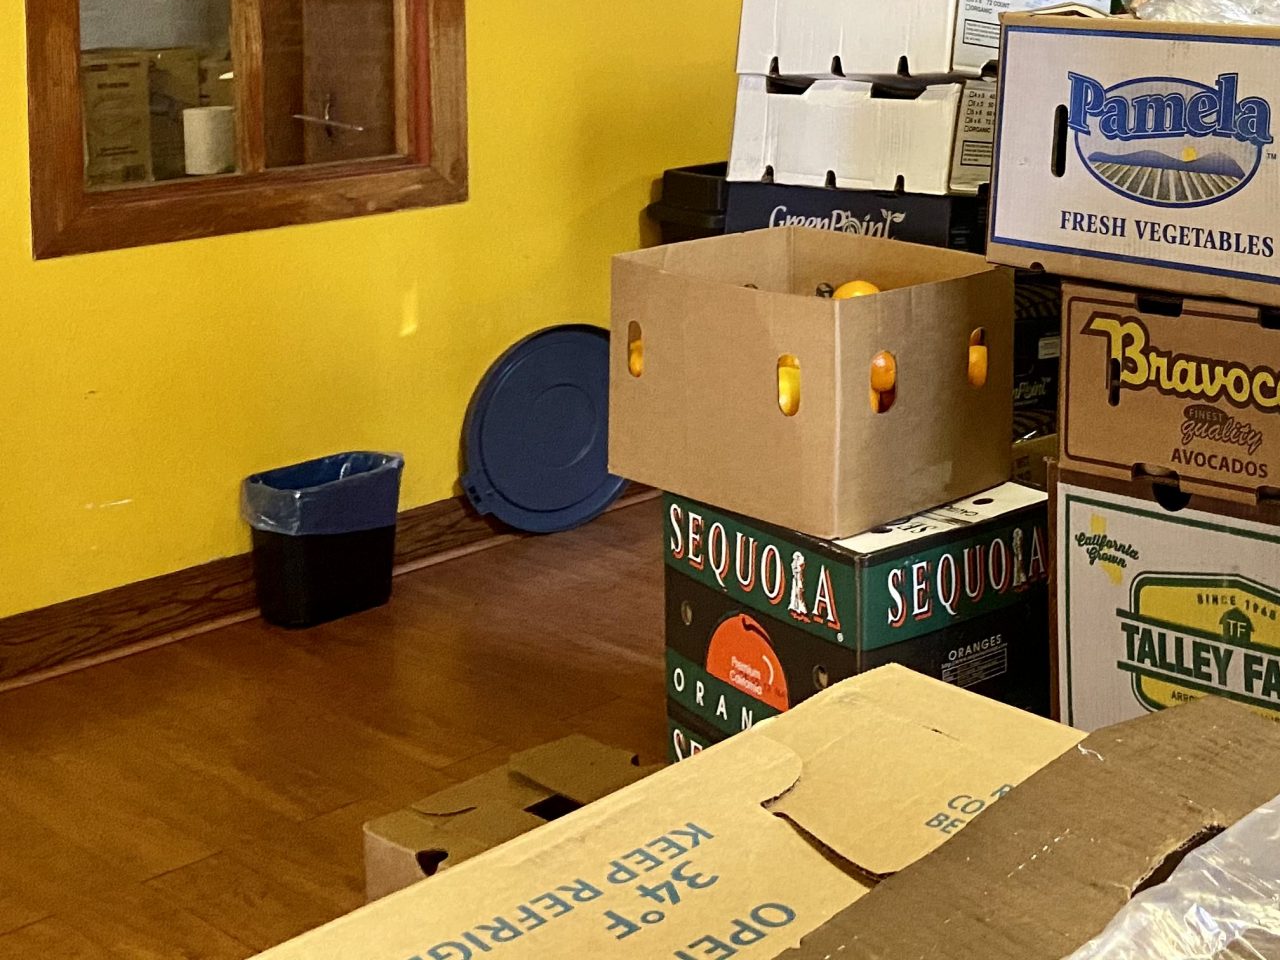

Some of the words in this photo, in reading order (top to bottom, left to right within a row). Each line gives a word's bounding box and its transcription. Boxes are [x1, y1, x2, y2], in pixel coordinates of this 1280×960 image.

[1067, 71, 1274, 144] Pamela
[1060, 210, 1127, 238] FRESH
[1134, 220, 1275, 258] VEGETABLES
[1188, 407, 1225, 423] FINEST
[1180, 416, 1262, 456] quality
[1171, 448, 1268, 478] AVOCADOS
[1075, 532, 1139, 560] California
[1087, 547, 1127, 568] Grown
[1197, 593, 1237, 607] SINCE
[1227, 620, 1247, 638] TF
[949, 634, 1002, 661] ORANGES
[1121, 622, 1233, 686] TALLEY
[607, 822, 714, 885] KEEP
[407, 878, 603, 960] REFRIG
[674, 902, 797, 960] OPE
